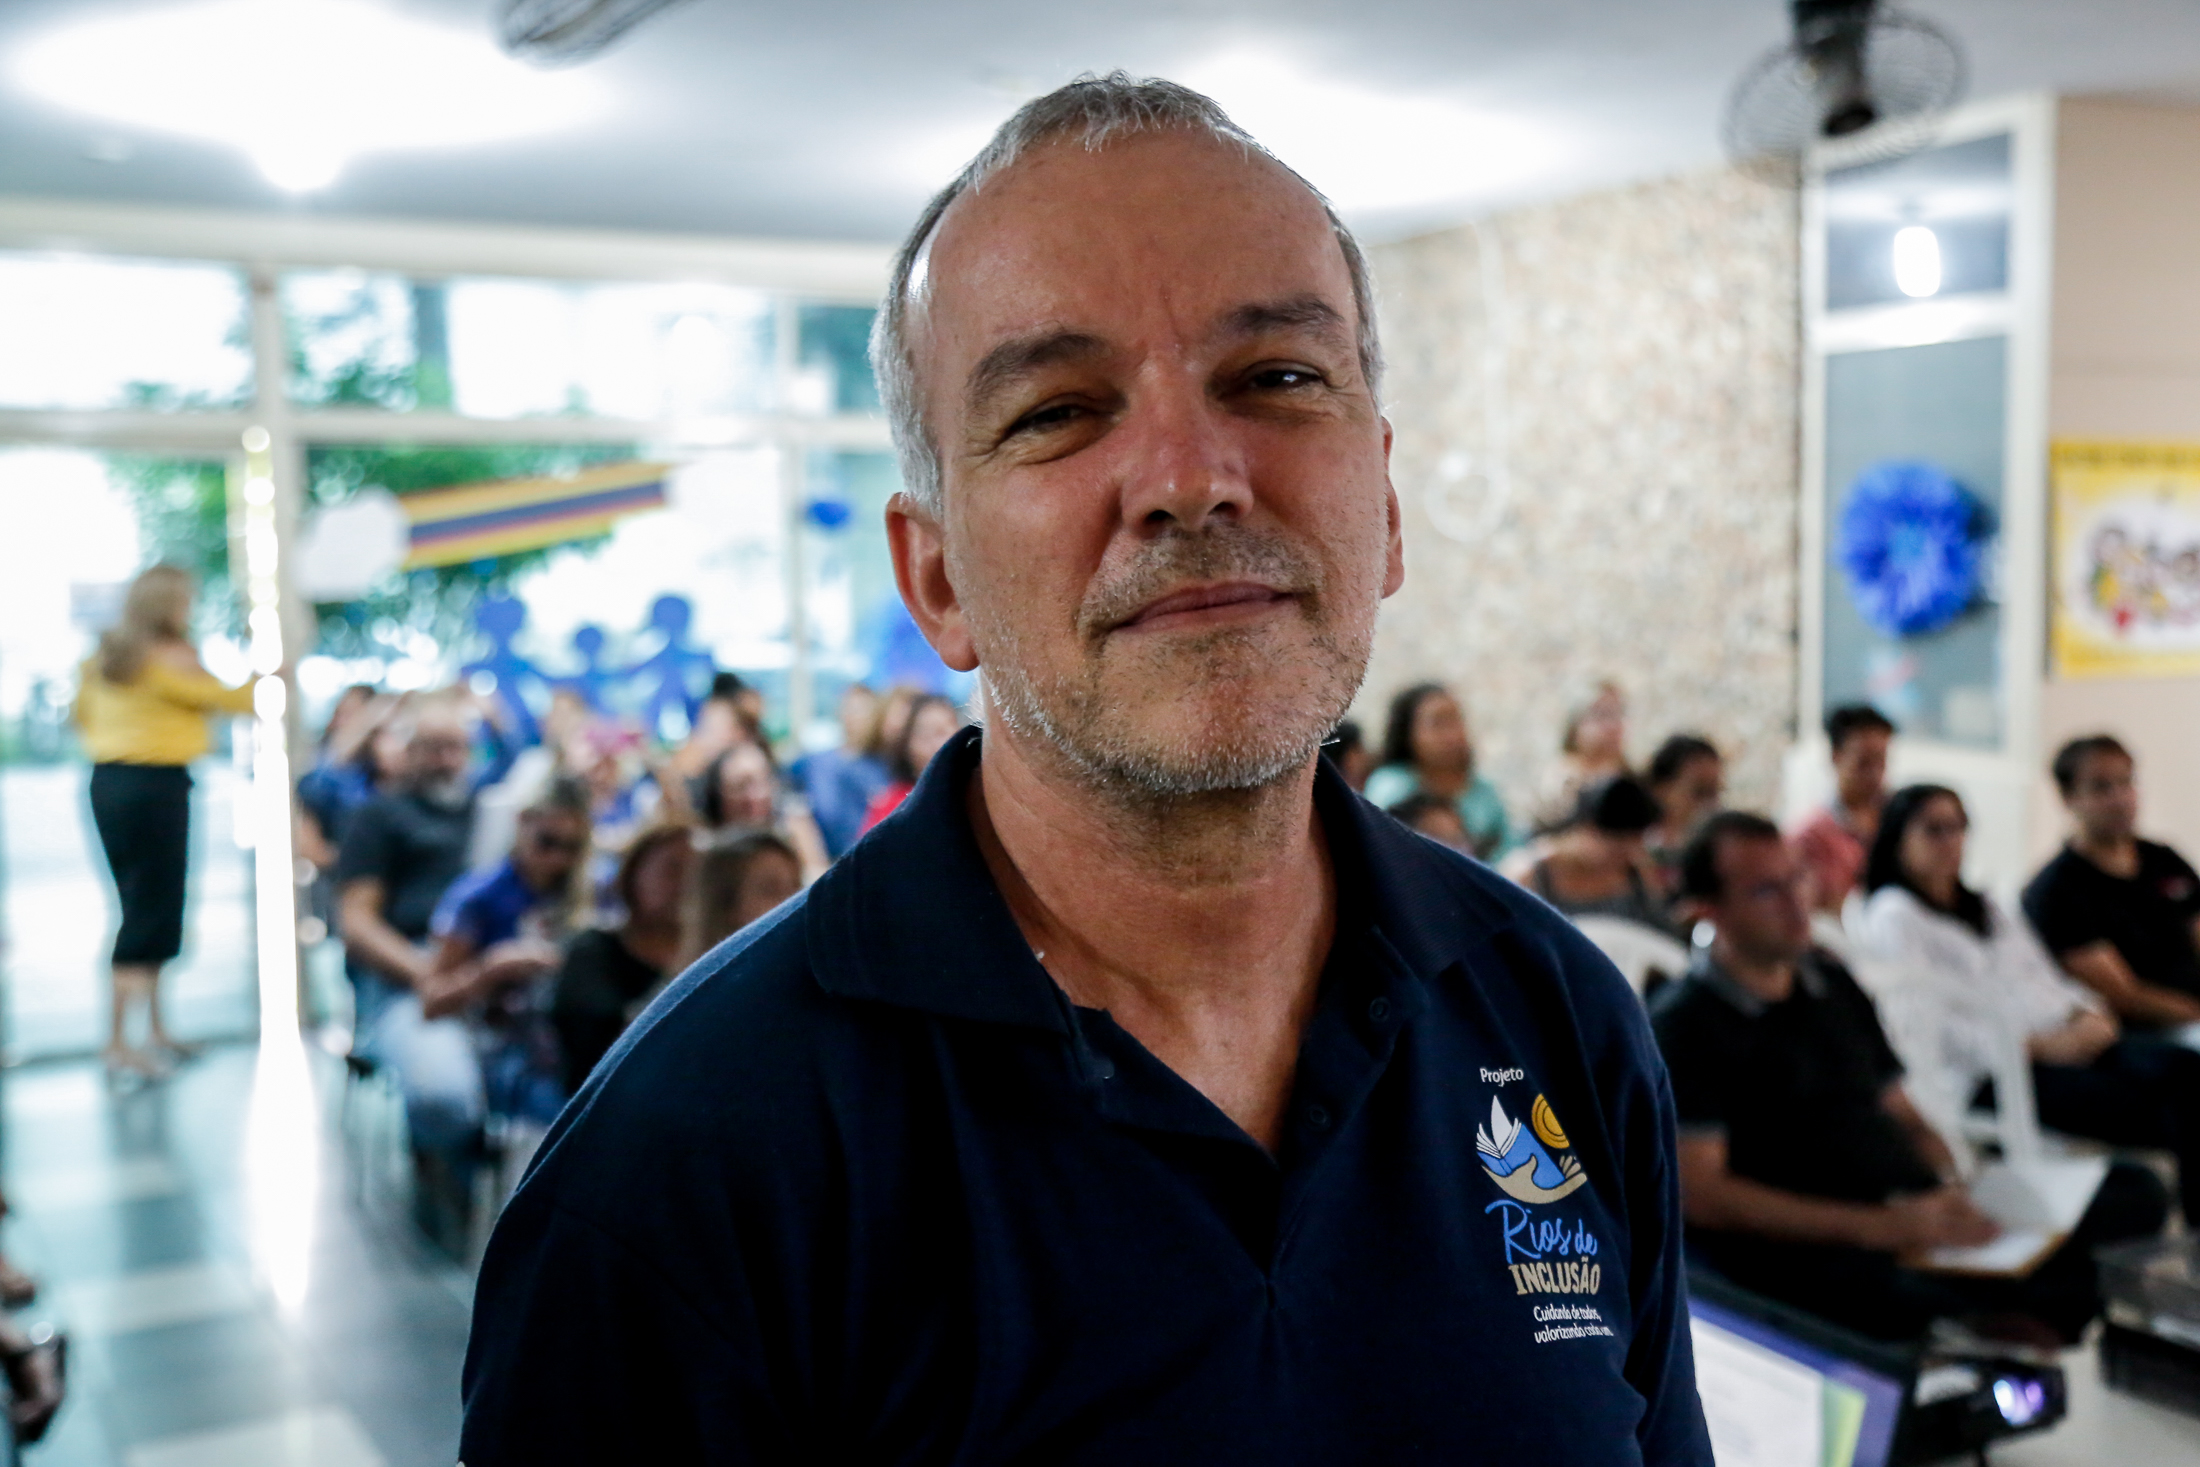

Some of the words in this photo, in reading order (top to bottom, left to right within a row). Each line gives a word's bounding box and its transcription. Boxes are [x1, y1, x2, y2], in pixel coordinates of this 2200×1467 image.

[1480, 1067, 1524, 1087] Projeto
[1485, 1200, 1571, 1264] Rios
[1575, 1218, 1598, 1256] de
[1508, 1256, 1600, 1295] INCLUSÃO
[1534, 1323, 1586, 1344] valorizando
